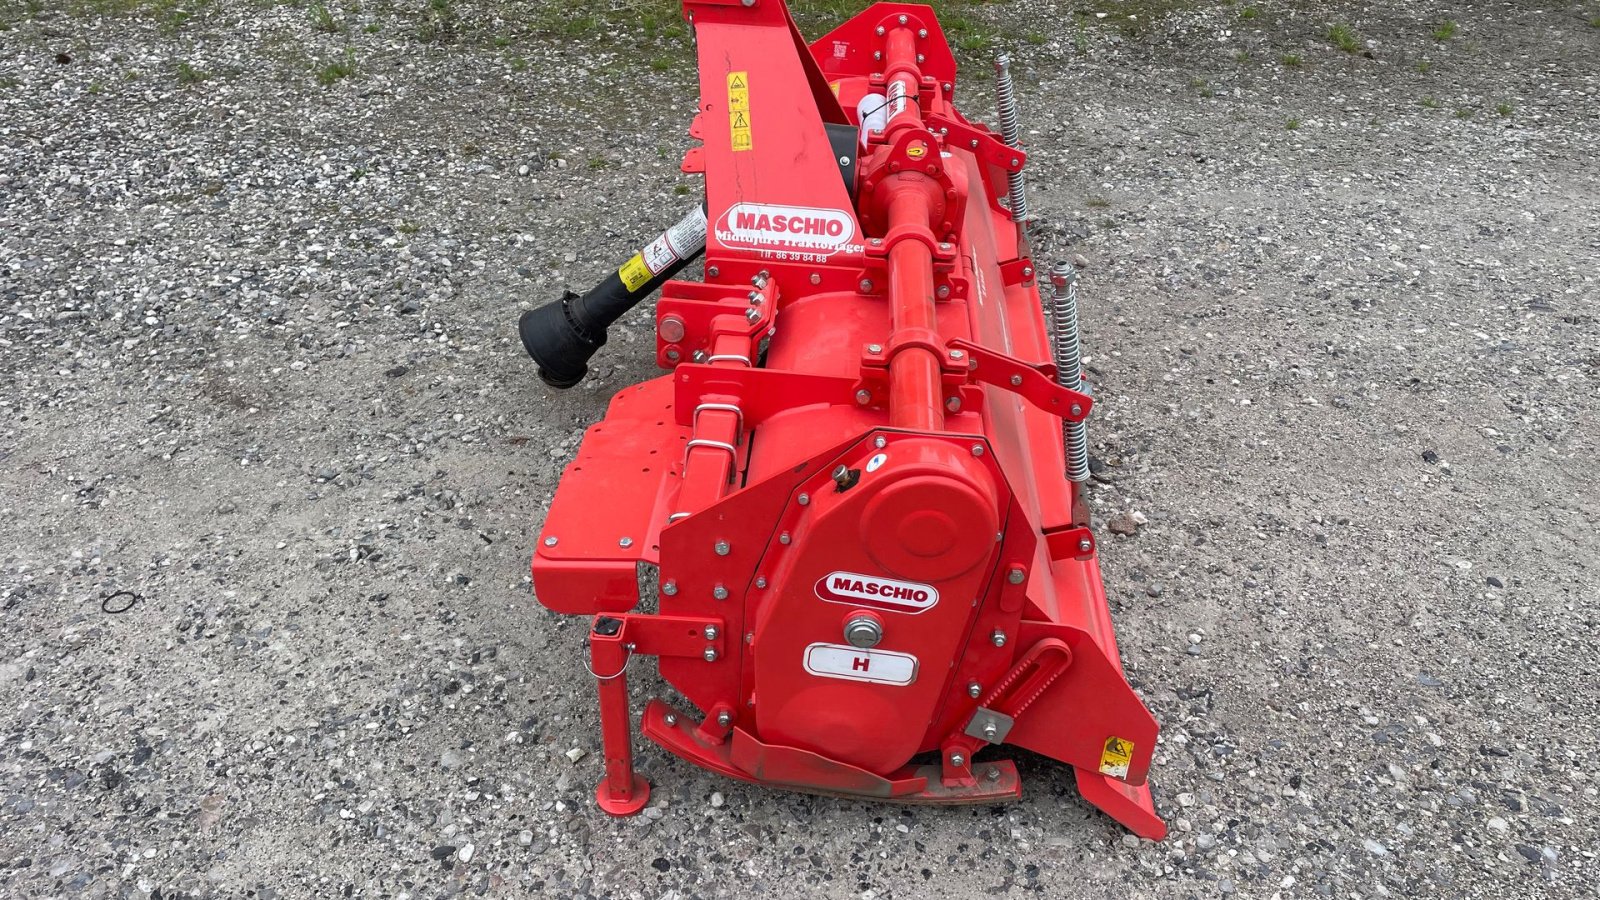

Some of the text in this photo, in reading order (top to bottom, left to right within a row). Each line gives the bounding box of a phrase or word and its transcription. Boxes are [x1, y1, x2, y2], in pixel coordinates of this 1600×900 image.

[736, 212, 844, 237] MASCHIO
[776, 251, 787, 260] 86
[789, 252, 800, 261] 39
[802, 253, 814, 262] 84
[816, 254, 827, 263] 88
[833, 577, 929, 602] MASCHIO
[852, 657, 870, 672] H
